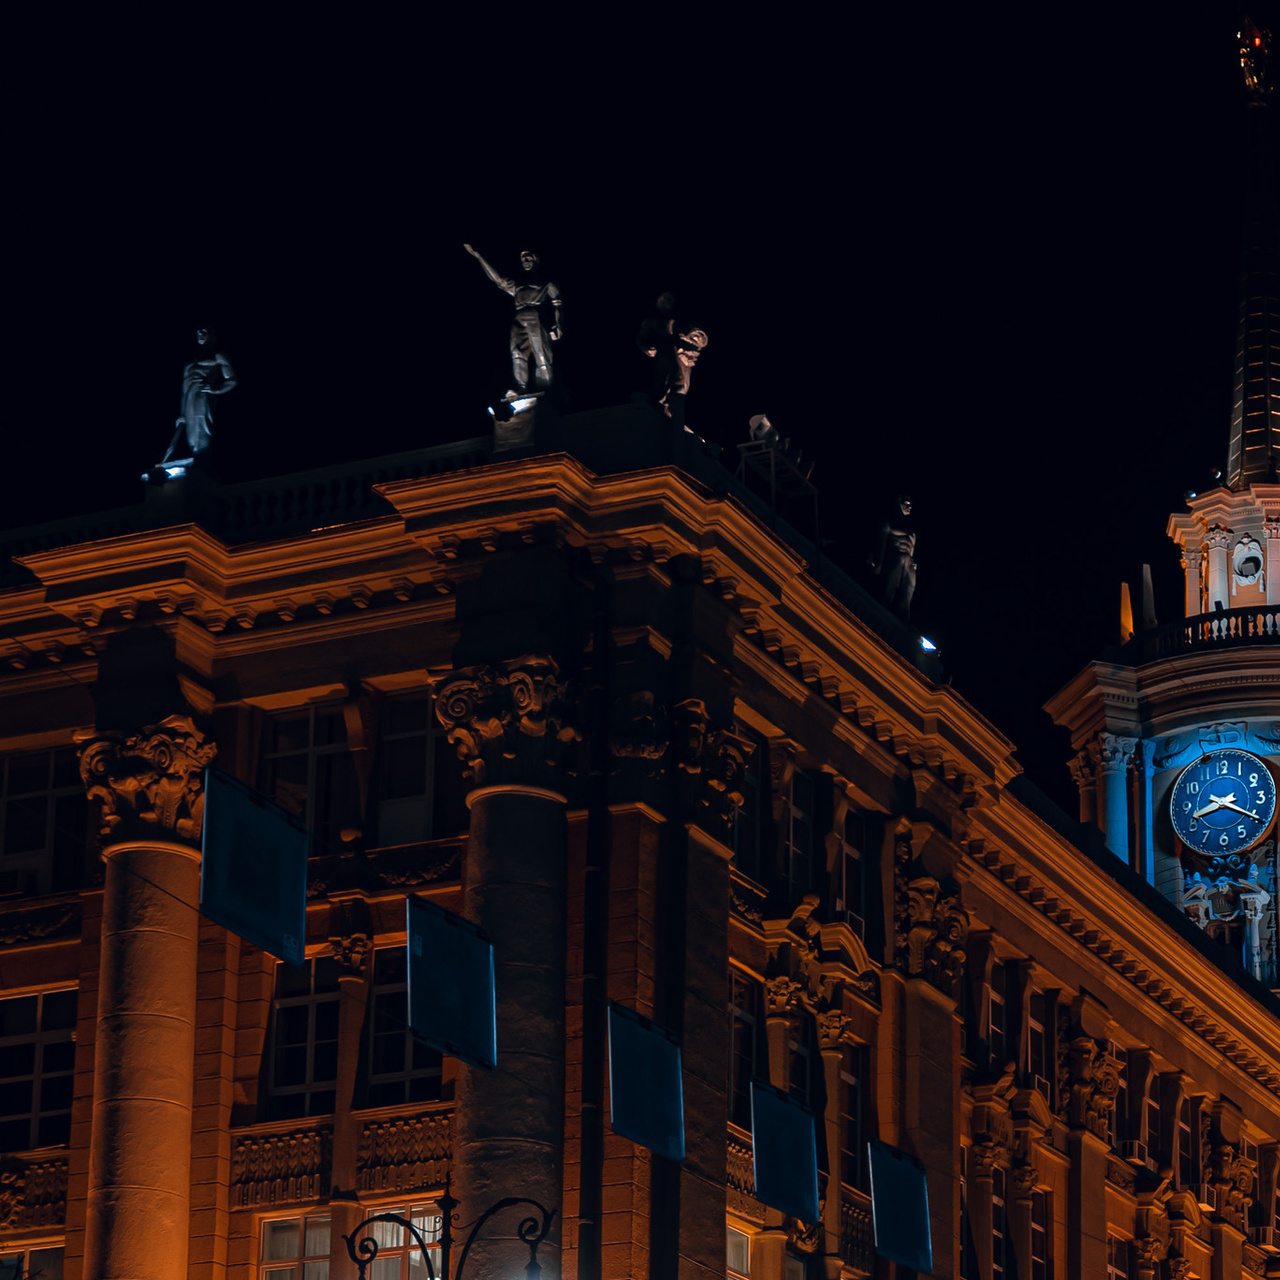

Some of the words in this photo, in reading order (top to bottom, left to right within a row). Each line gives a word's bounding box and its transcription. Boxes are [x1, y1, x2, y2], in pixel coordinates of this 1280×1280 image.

[1216, 760, 1228, 775] 12
[1237, 761, 1242, 776] 1
[1249, 773, 1259, 788] 2
[1186, 781, 1199, 795] 10
[1256, 790, 1266, 805] 3
[1182, 801, 1191, 815] 9
[1189, 818, 1197, 832] 8
[1237, 825, 1247, 839] 5
[1202, 830, 1211, 844] 7
[1219, 832, 1229, 847] 6
